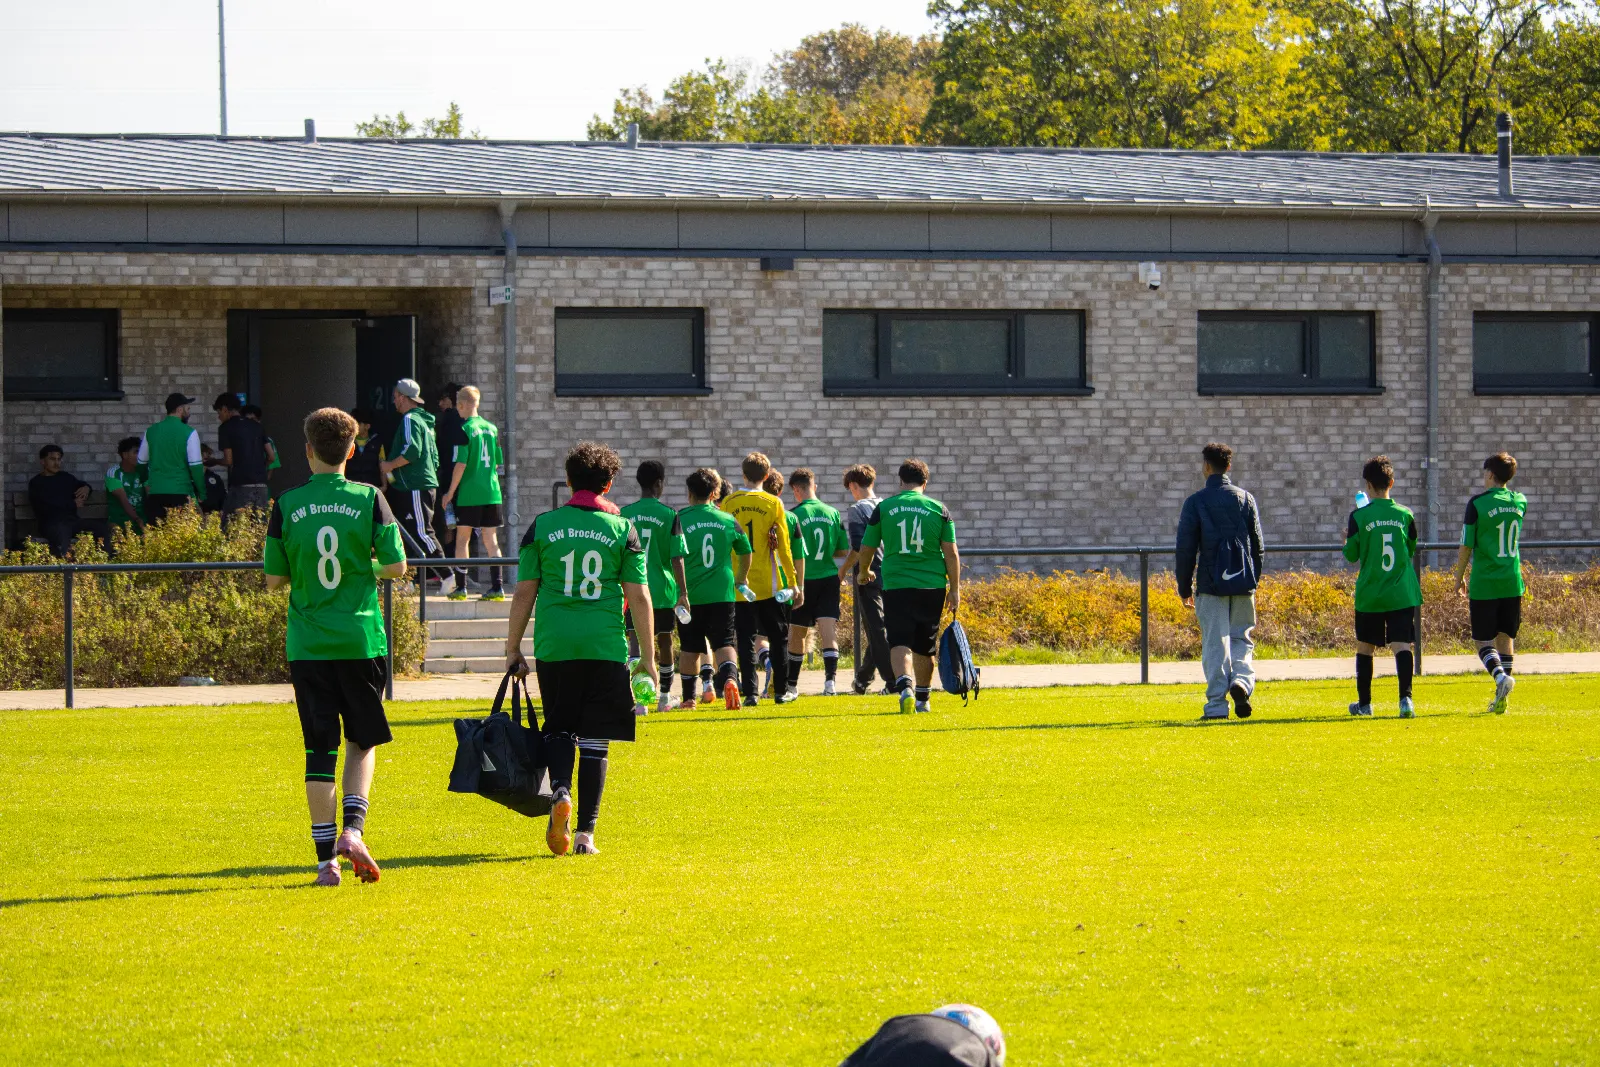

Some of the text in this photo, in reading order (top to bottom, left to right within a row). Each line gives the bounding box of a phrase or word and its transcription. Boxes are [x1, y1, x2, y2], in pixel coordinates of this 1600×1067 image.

[375, 386, 385, 410] 2
[480, 437, 491, 468] 4
[291, 502, 362, 523] GW Brockdorf
[637, 514, 665, 528] Brockdorf
[741, 505, 768, 517] Brockdorf
[801, 518, 812, 527] GW
[888, 505, 931, 517] GW Brockdorf
[1487, 507, 1498, 518] GW
[548, 527, 616, 548] GW Brockdorf
[686, 521, 726, 534] GW Brockdorf
[745, 518, 756, 554] 1
[896, 515, 925, 555] 14
[1365, 521, 1376, 532] GW
[1496, 519, 1520, 558] 10
[316, 525, 342, 590] 8
[641, 527, 652, 564] 7
[701, 533, 715, 569] 6
[813, 527, 825, 561] 2
[1381, 532, 1395, 572] 5
[559, 548, 603, 600] 18
